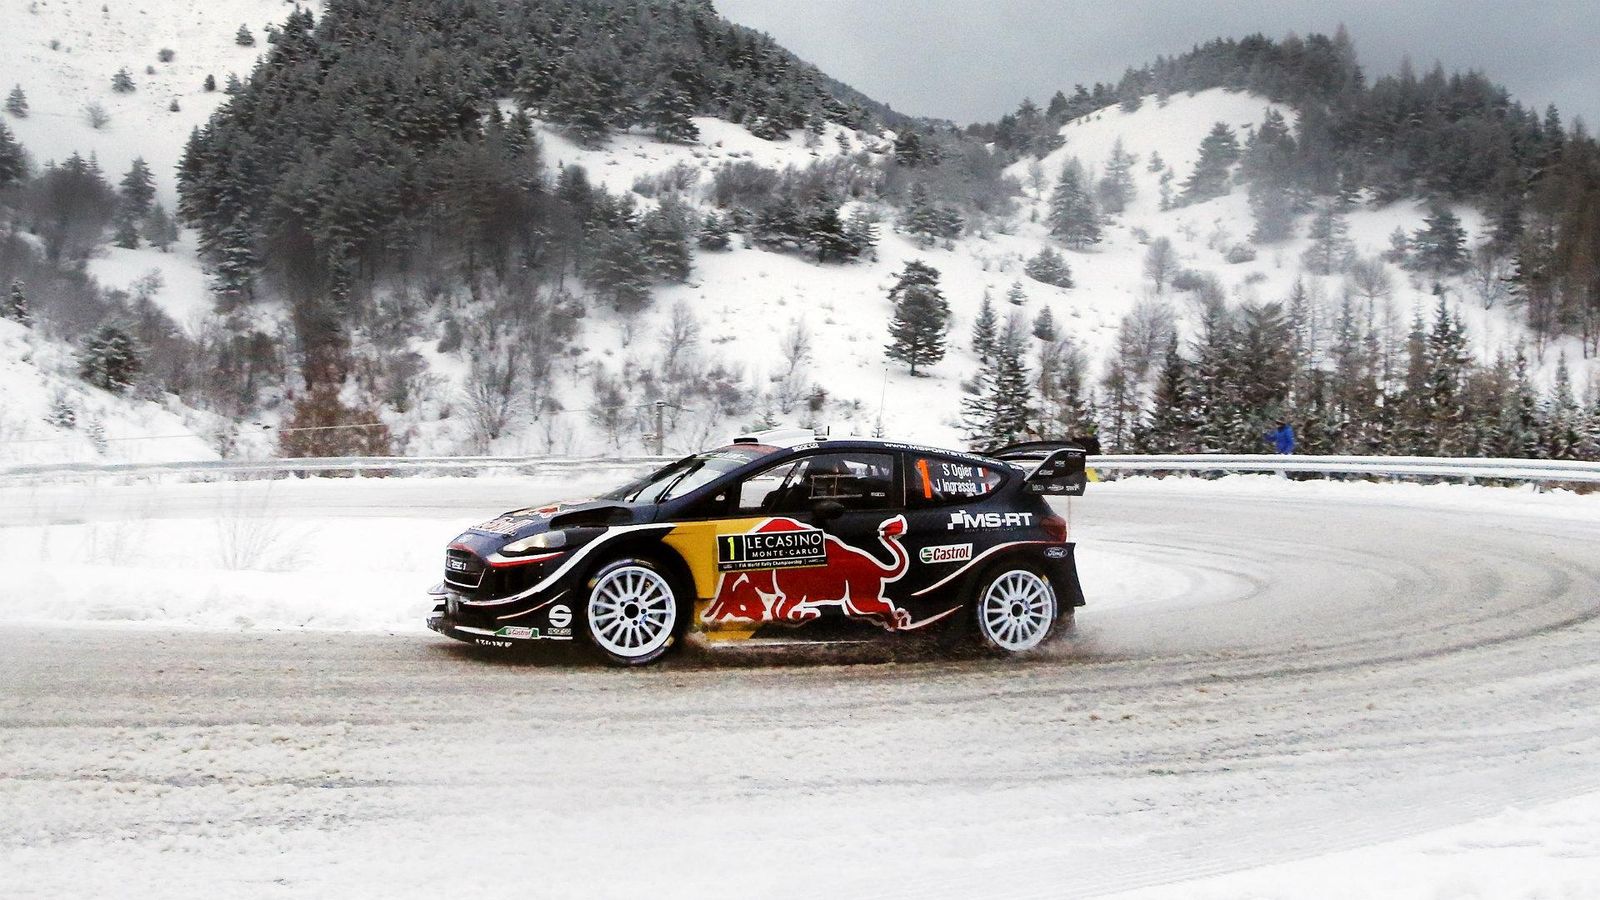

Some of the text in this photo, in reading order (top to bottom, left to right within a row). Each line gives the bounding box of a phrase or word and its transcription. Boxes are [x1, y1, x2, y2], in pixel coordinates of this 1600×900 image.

[916, 458, 932, 499] 1
[942, 463, 973, 479] S Ogier
[936, 478, 977, 495] J Ingrassia
[727, 536, 735, 560] 1
[747, 533, 822, 549] LE CASINO
[933, 546, 970, 561] Castrol
[1047, 549, 1064, 557] Ford
[748, 560, 760, 568] World
[761, 560, 772, 568] Rally
